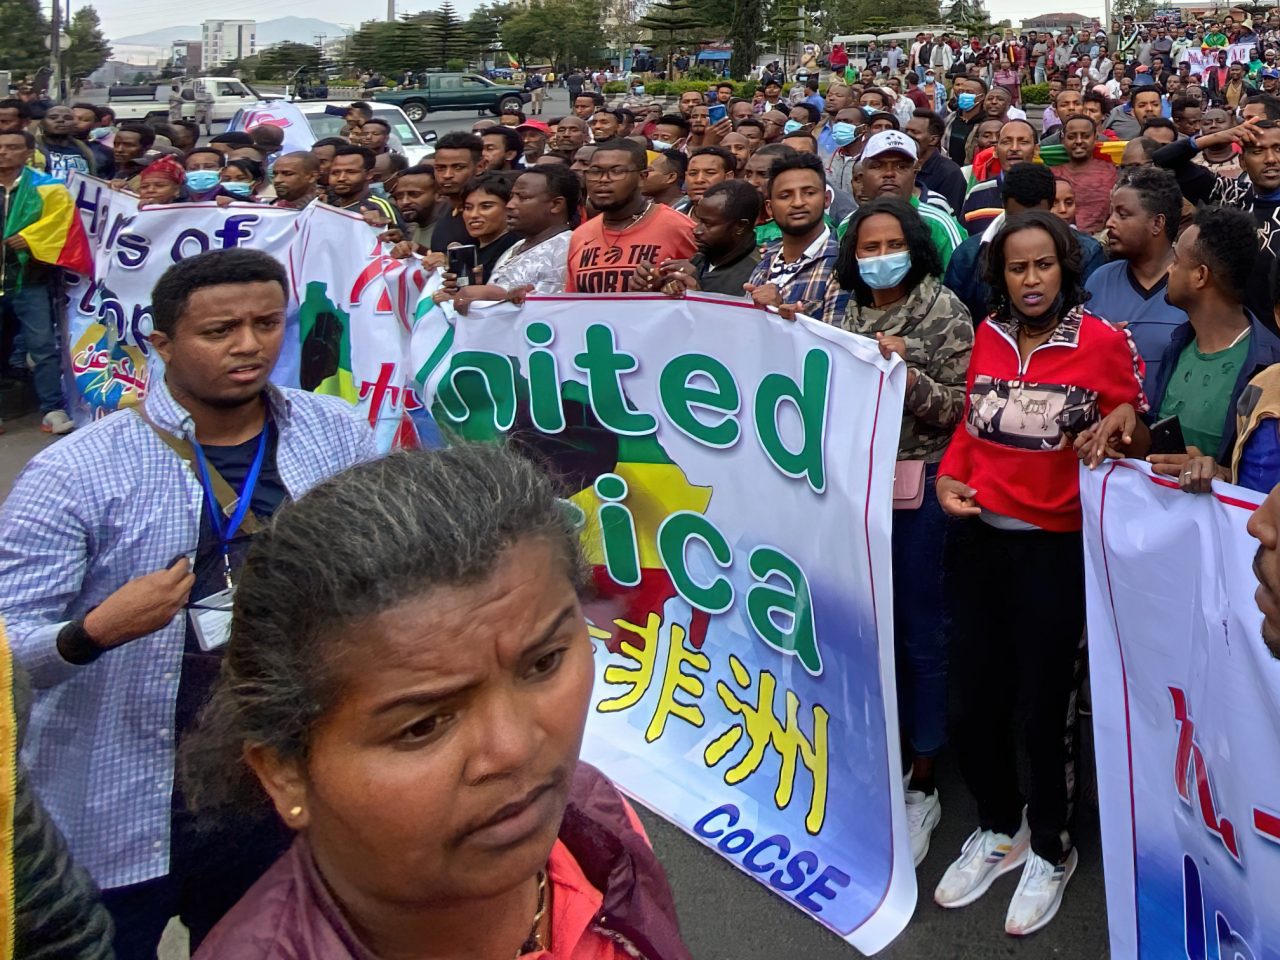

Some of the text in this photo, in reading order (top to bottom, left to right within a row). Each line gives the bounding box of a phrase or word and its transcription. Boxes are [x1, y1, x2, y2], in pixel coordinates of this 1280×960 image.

[579, 244, 662, 269] WE THE
[588, 611, 829, 836] 非洲
[693, 803, 850, 913] CoCSE
